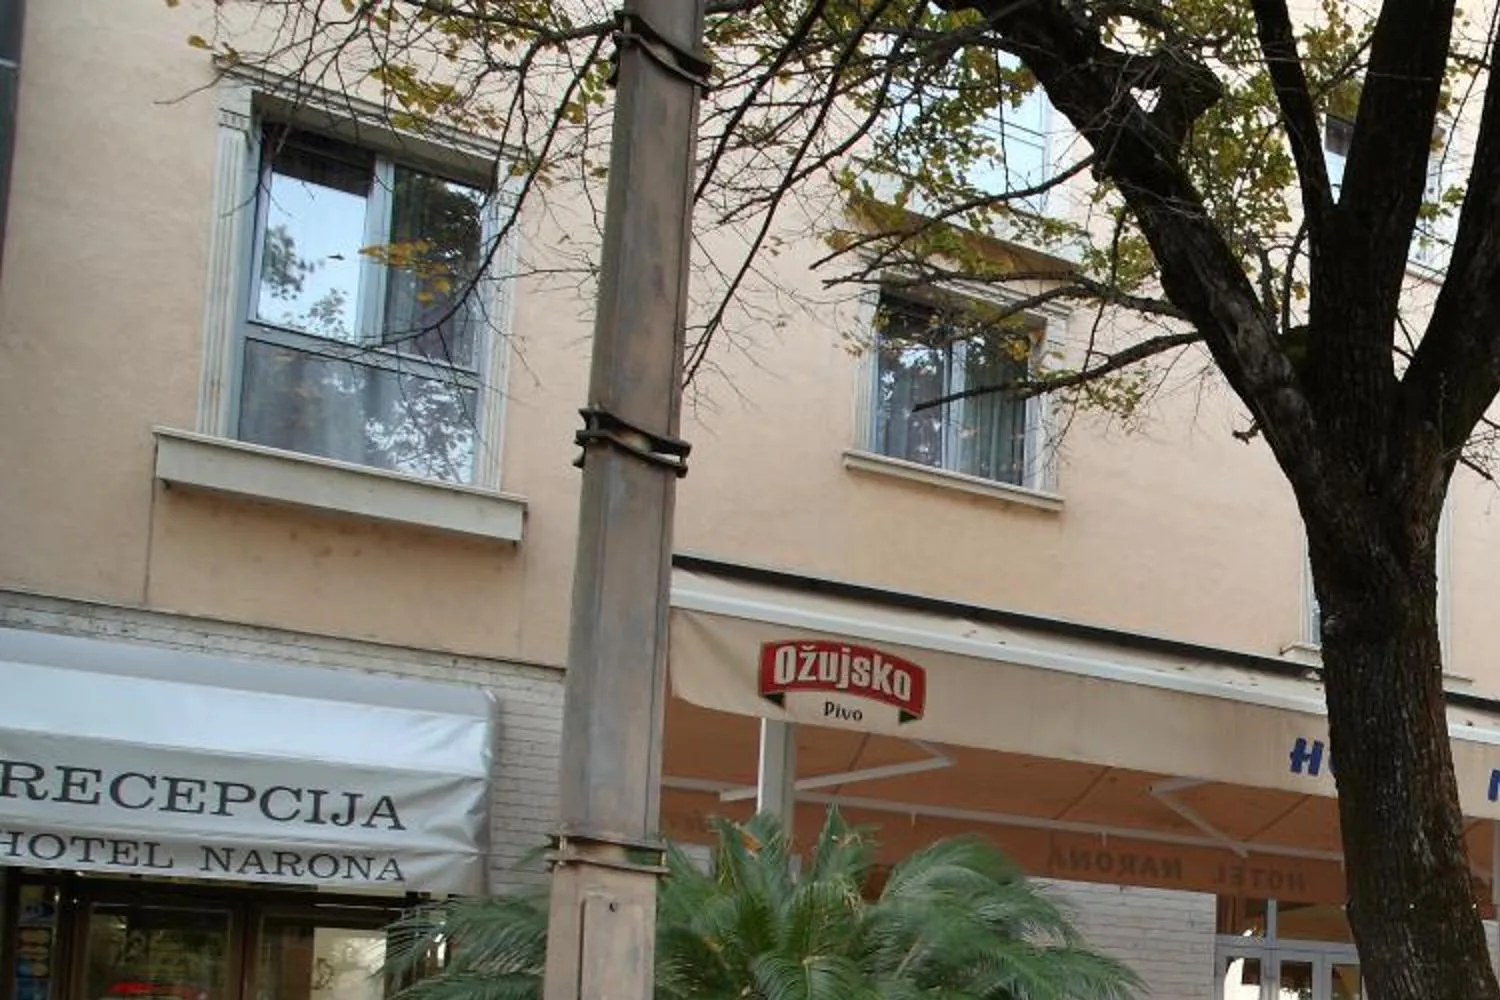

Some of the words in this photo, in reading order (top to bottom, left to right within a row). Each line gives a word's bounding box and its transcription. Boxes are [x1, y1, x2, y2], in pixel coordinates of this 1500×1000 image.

[773, 644, 912, 702] Ožujsko
[824, 701, 864, 723] Pivo
[0, 759, 407, 832] RECEPCIJA
[0, 829, 174, 870] HOTEL
[199, 845, 407, 882] NARONA
